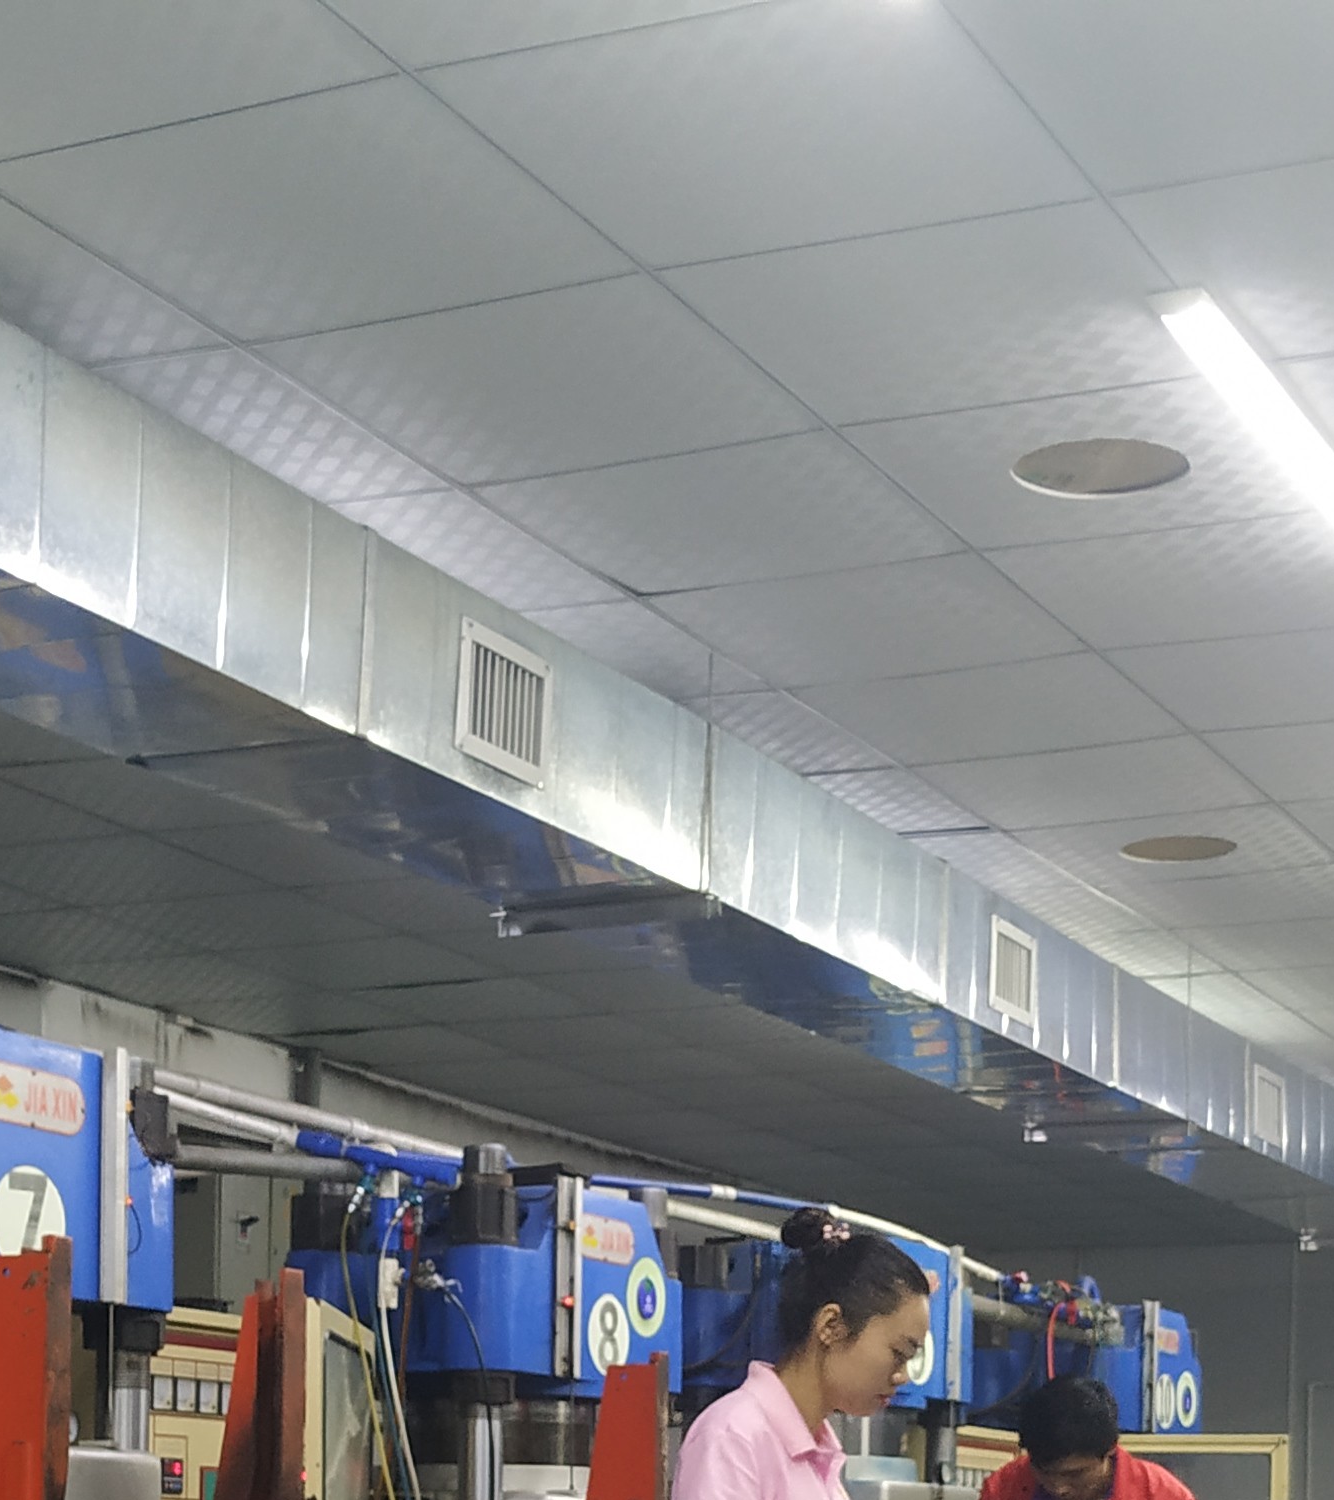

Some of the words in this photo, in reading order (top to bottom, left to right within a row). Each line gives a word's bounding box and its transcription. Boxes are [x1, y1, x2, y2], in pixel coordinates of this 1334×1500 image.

[23, 1082, 48, 1117] JIA
[52, 1087, 78, 1123] XIN
[8, 1172, 48, 1251] 7
[598, 1300, 620, 1373] 8
